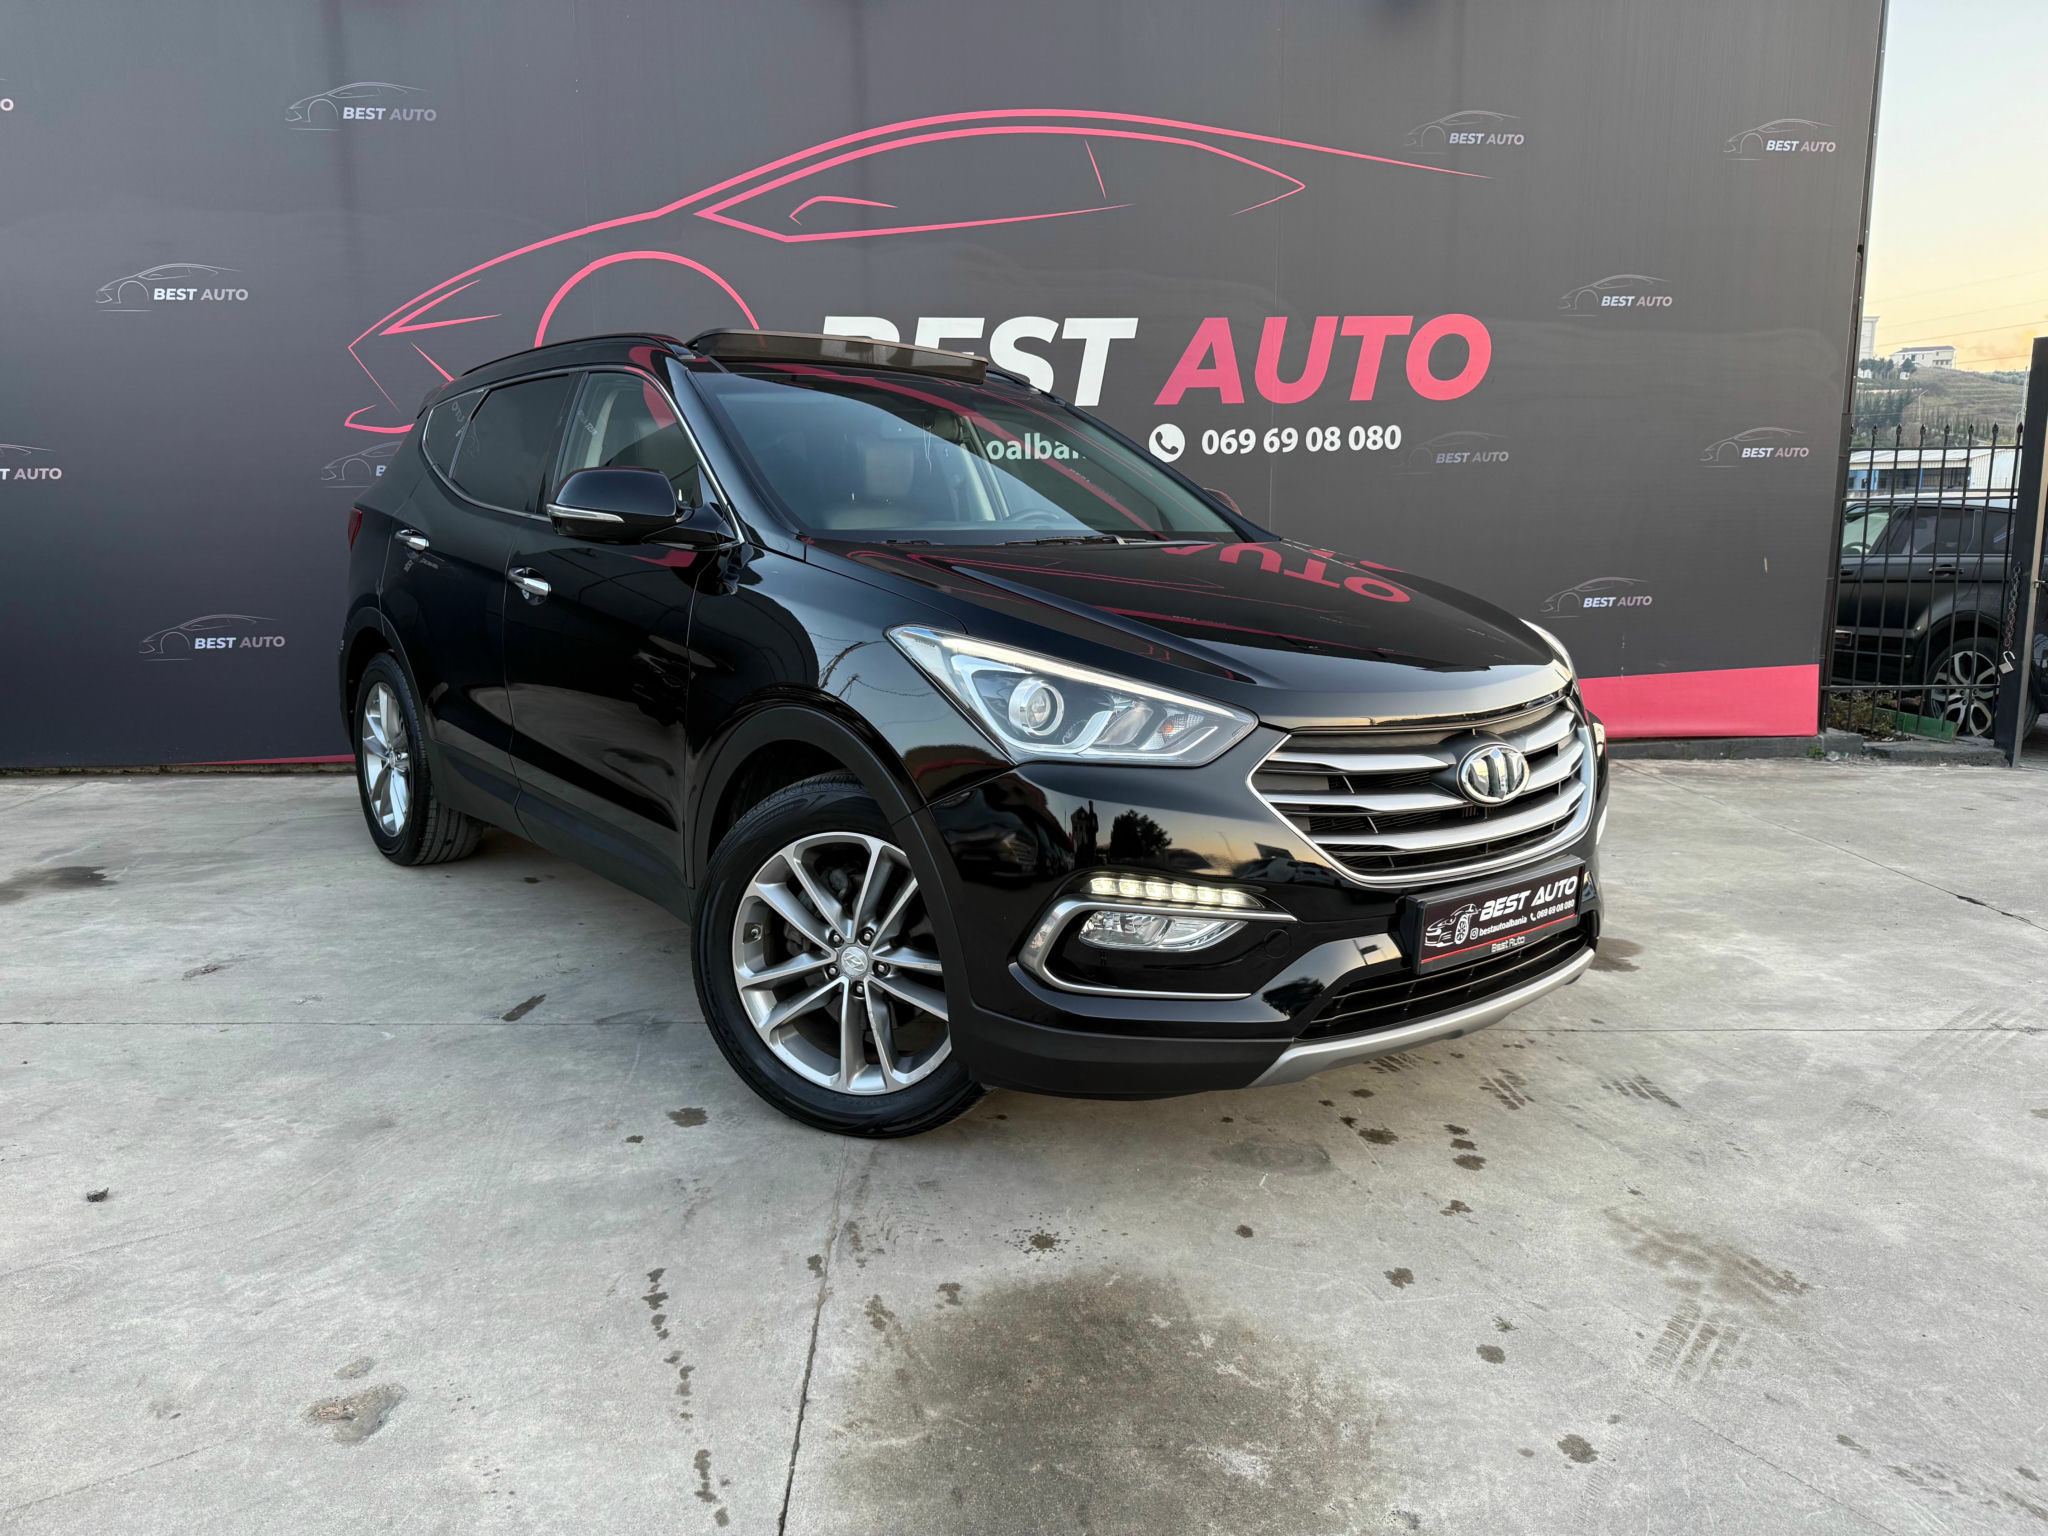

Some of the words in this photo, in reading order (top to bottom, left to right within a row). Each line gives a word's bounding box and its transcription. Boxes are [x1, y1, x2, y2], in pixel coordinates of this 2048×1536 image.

[342, 107, 386, 120] BEST
[389, 108, 437, 121] AUTO
[1449, 132, 1485, 145] BEST
[1486, 133, 1525, 145] AUTO
[1765, 140, 1800, 152] BEST
[1800, 141, 1837, 153] AUTO
[153, 288, 197, 301] BEST
[200, 288, 249, 301] AUTO
[1600, 295, 1636, 307] BEST
[1636, 296, 1673, 307] AUTO
[1154, 313, 1493, 406] AUTO
[1201, 428, 1257, 455] 069
[1263, 427, 1299, 454] 69
[1305, 426, 1342, 453] 08
[1348, 424, 1402, 451] 080
[1435, 451, 1471, 463] BEST
[1471, 451, 1510, 463] AUTO
[1740, 447, 1774, 458] BEST
[1774, 447, 1810, 458] AUTO
[13, 467, 63, 480] AUTO
[1582, 596, 1617, 608] BEST
[1617, 595, 1653, 607] AUTO
[194, 636, 237, 650] BEST
[239, 636, 286, 648] AUTO
[1479, 890, 1532, 922] BEST
[1531, 876, 1578, 907] AUTO
[1479, 916, 1528, 937] bestautoalbania
[1491, 939, 1509, 953] Best
